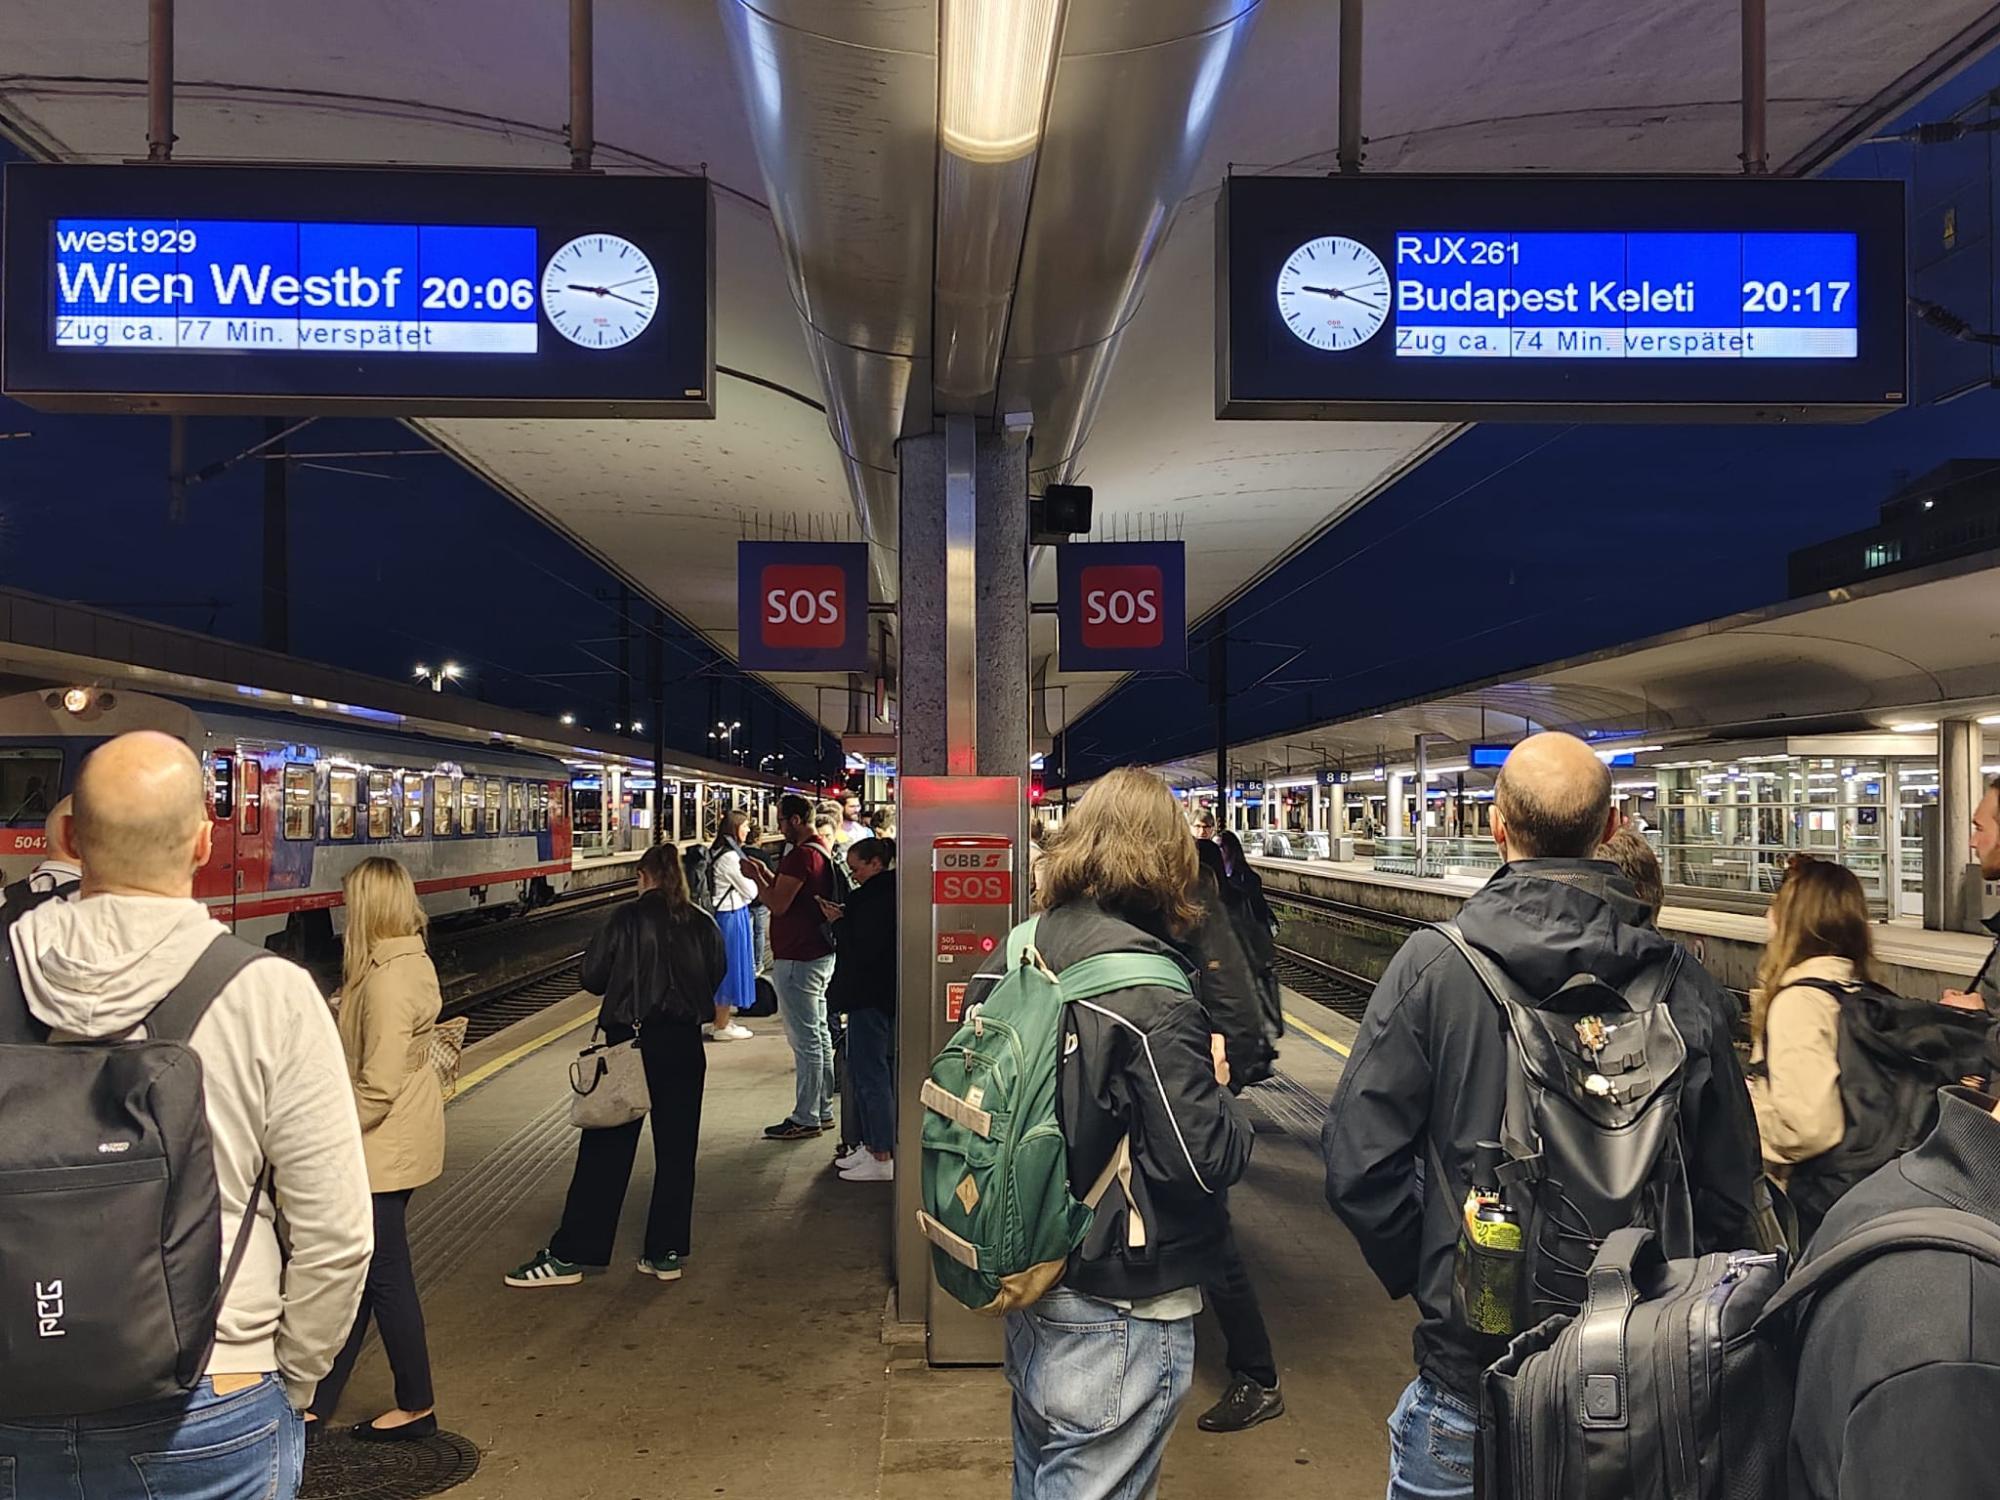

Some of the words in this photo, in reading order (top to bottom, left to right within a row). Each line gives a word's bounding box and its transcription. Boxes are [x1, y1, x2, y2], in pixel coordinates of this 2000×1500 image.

[141, 229, 197, 253] 929
[1397, 237, 1466, 264] RJX
[1471, 241, 1520, 265] 261
[57, 262, 194, 305] Wien
[210, 263, 404, 308] Westbf
[421, 277, 534, 310] 20:06
[1398, 280, 1579, 317] Budapest
[1589, 281, 1695, 312] Keleti
[1741, 281, 1850, 312] 20:17
[57, 318, 109, 346] Zug
[122, 324, 164, 341] ca.
[179, 320, 212, 341] 77
[227, 320, 283, 342] Min.
[297, 323, 432, 349] verspätet
[1397, 329, 1446, 355] Zug
[1458, 334, 1498, 351] ca.
[1512, 330, 1543, 351] 74
[1557, 330, 1611, 351] Min.
[1624, 331, 1755, 355] verspätet
[767, 589, 838, 624] SOS
[1087, 590, 1157, 624] SOS
[14, 836, 47, 849] 5047
[943, 853, 981, 868] ÖBB
[943, 876, 1002, 899] SOS
[941, 936, 955, 944] SOS
